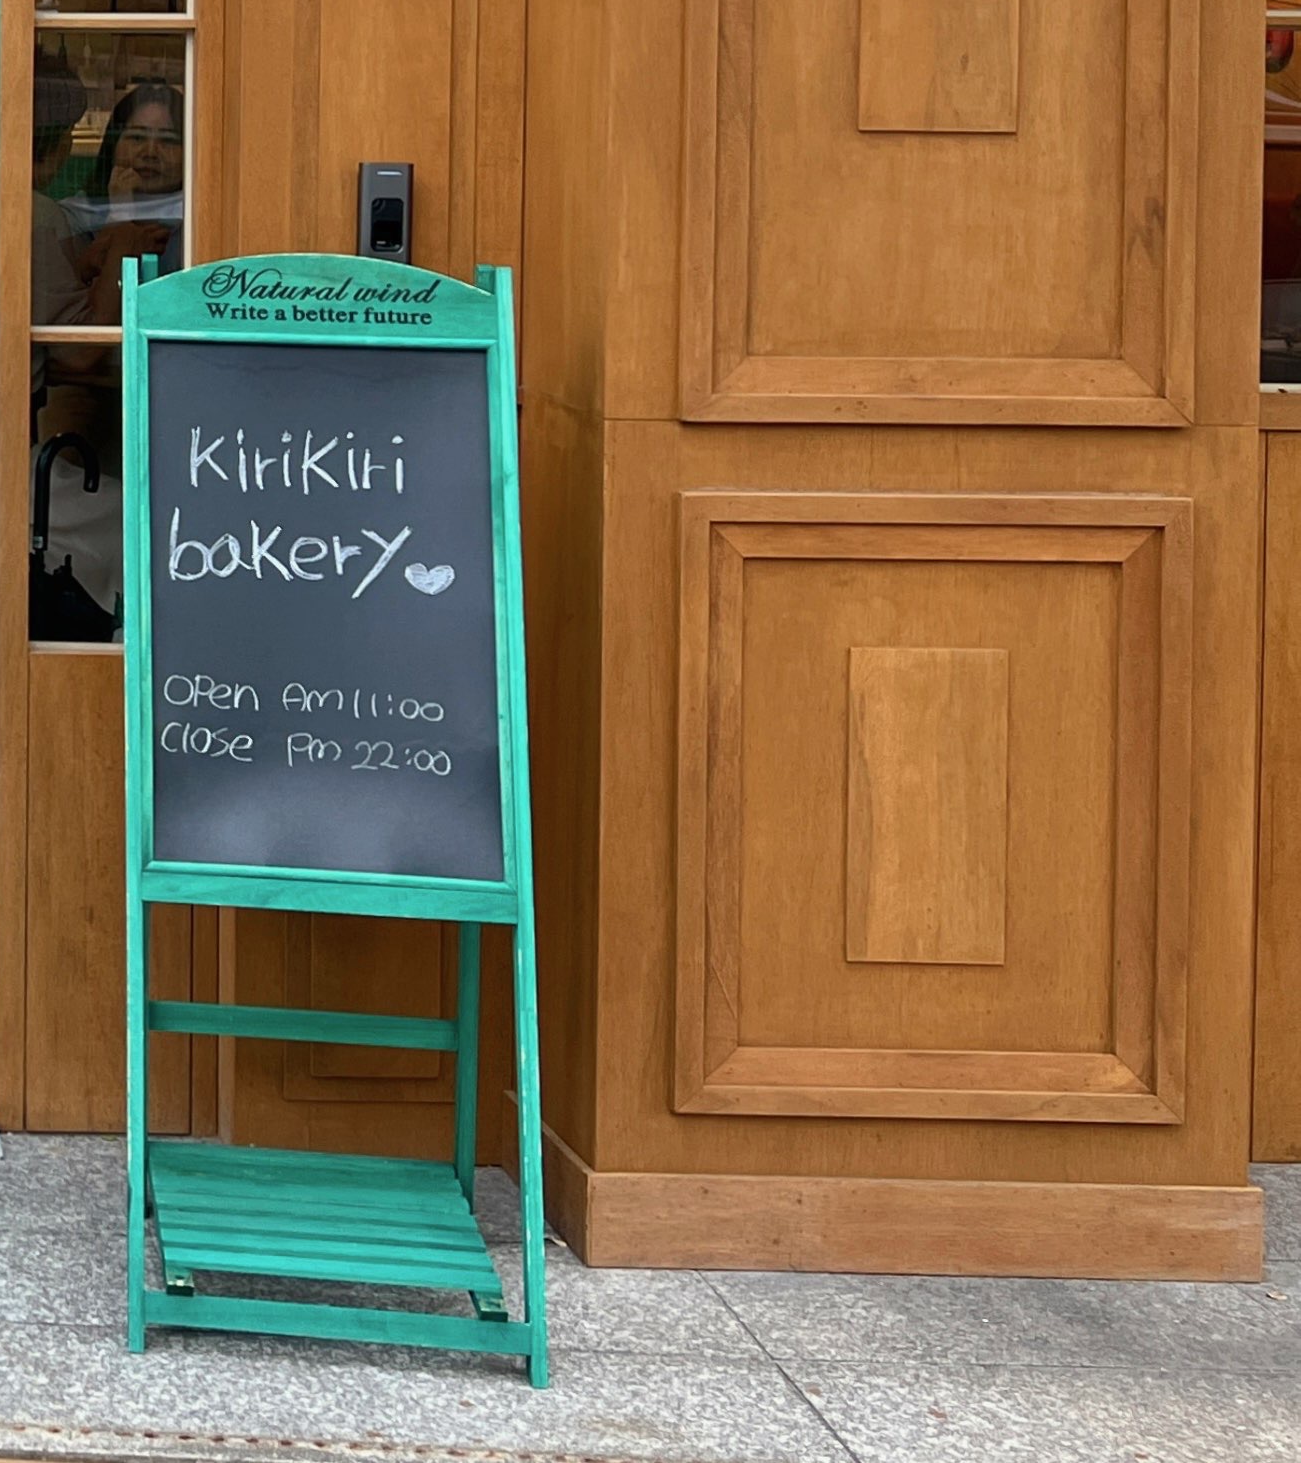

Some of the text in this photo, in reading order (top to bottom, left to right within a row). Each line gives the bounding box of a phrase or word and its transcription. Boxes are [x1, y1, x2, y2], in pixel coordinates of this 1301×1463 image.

[202, 264, 442, 305] Natural wind
[205, 302, 433, 326] Write a better future
[168, 506, 412, 599] bakery
[160, 721, 254, 763] Close
